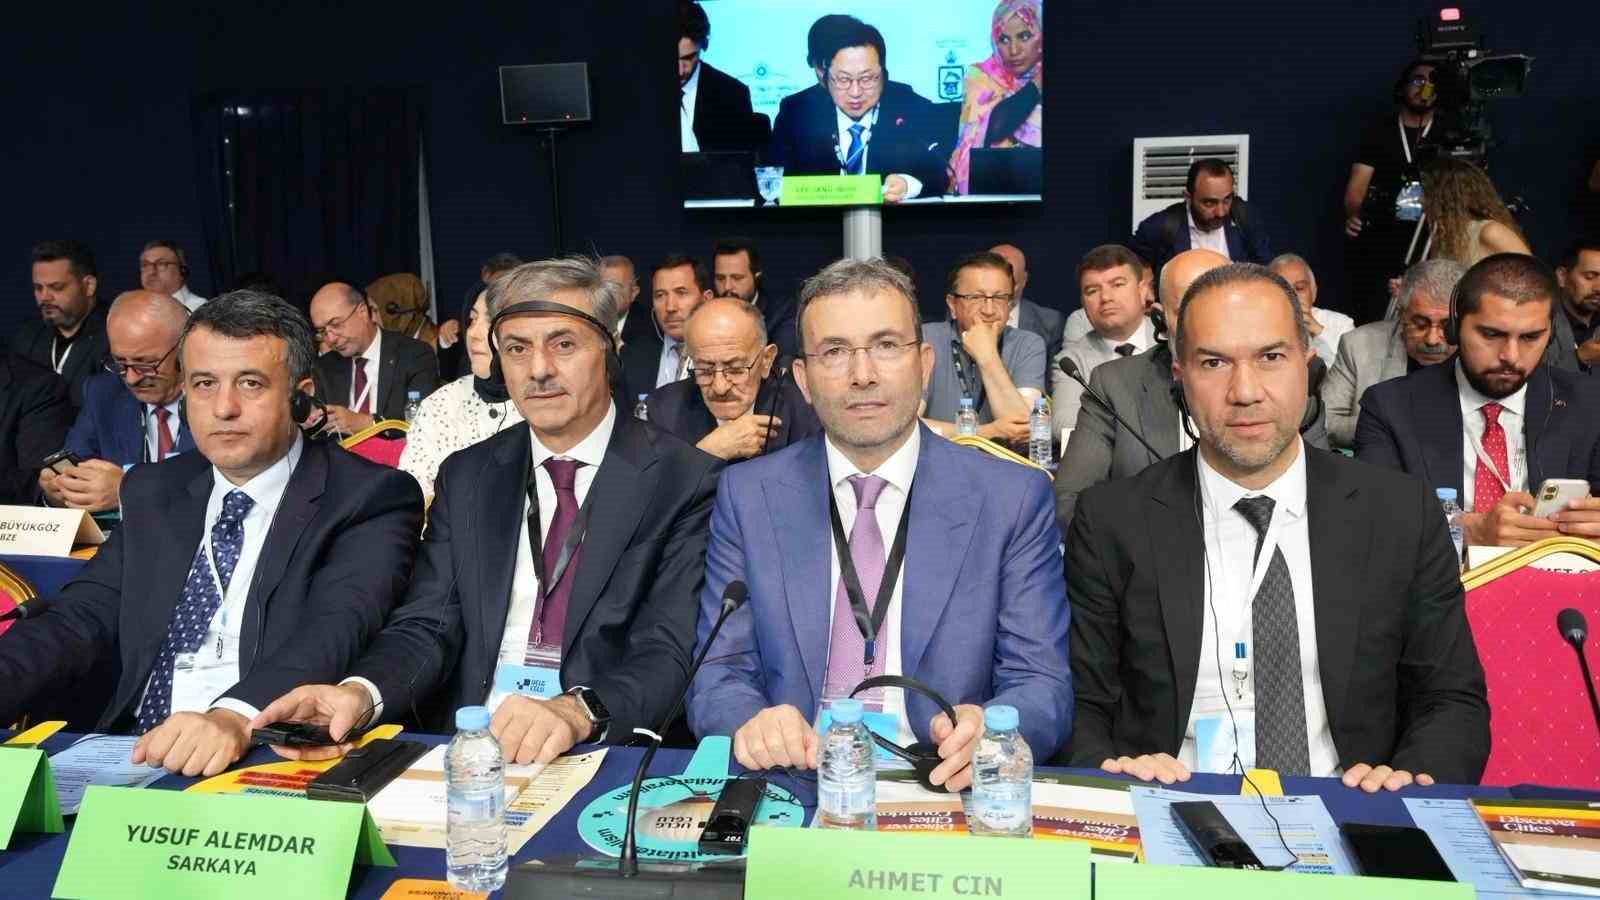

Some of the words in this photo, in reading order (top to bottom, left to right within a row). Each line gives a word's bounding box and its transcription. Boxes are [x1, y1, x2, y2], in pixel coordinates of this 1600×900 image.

[1499, 815, 1576, 827] Discover
[1503, 823, 1555, 834] Cities
[1083, 825, 1128, 836] Cities
[127, 824, 200, 846] YUSUF
[204, 830, 315, 855] ALEMDAR
[167, 855, 257, 876] SARKAYA
[848, 869, 944, 893] AHMET
[952, 875, 1003, 897] CIN
